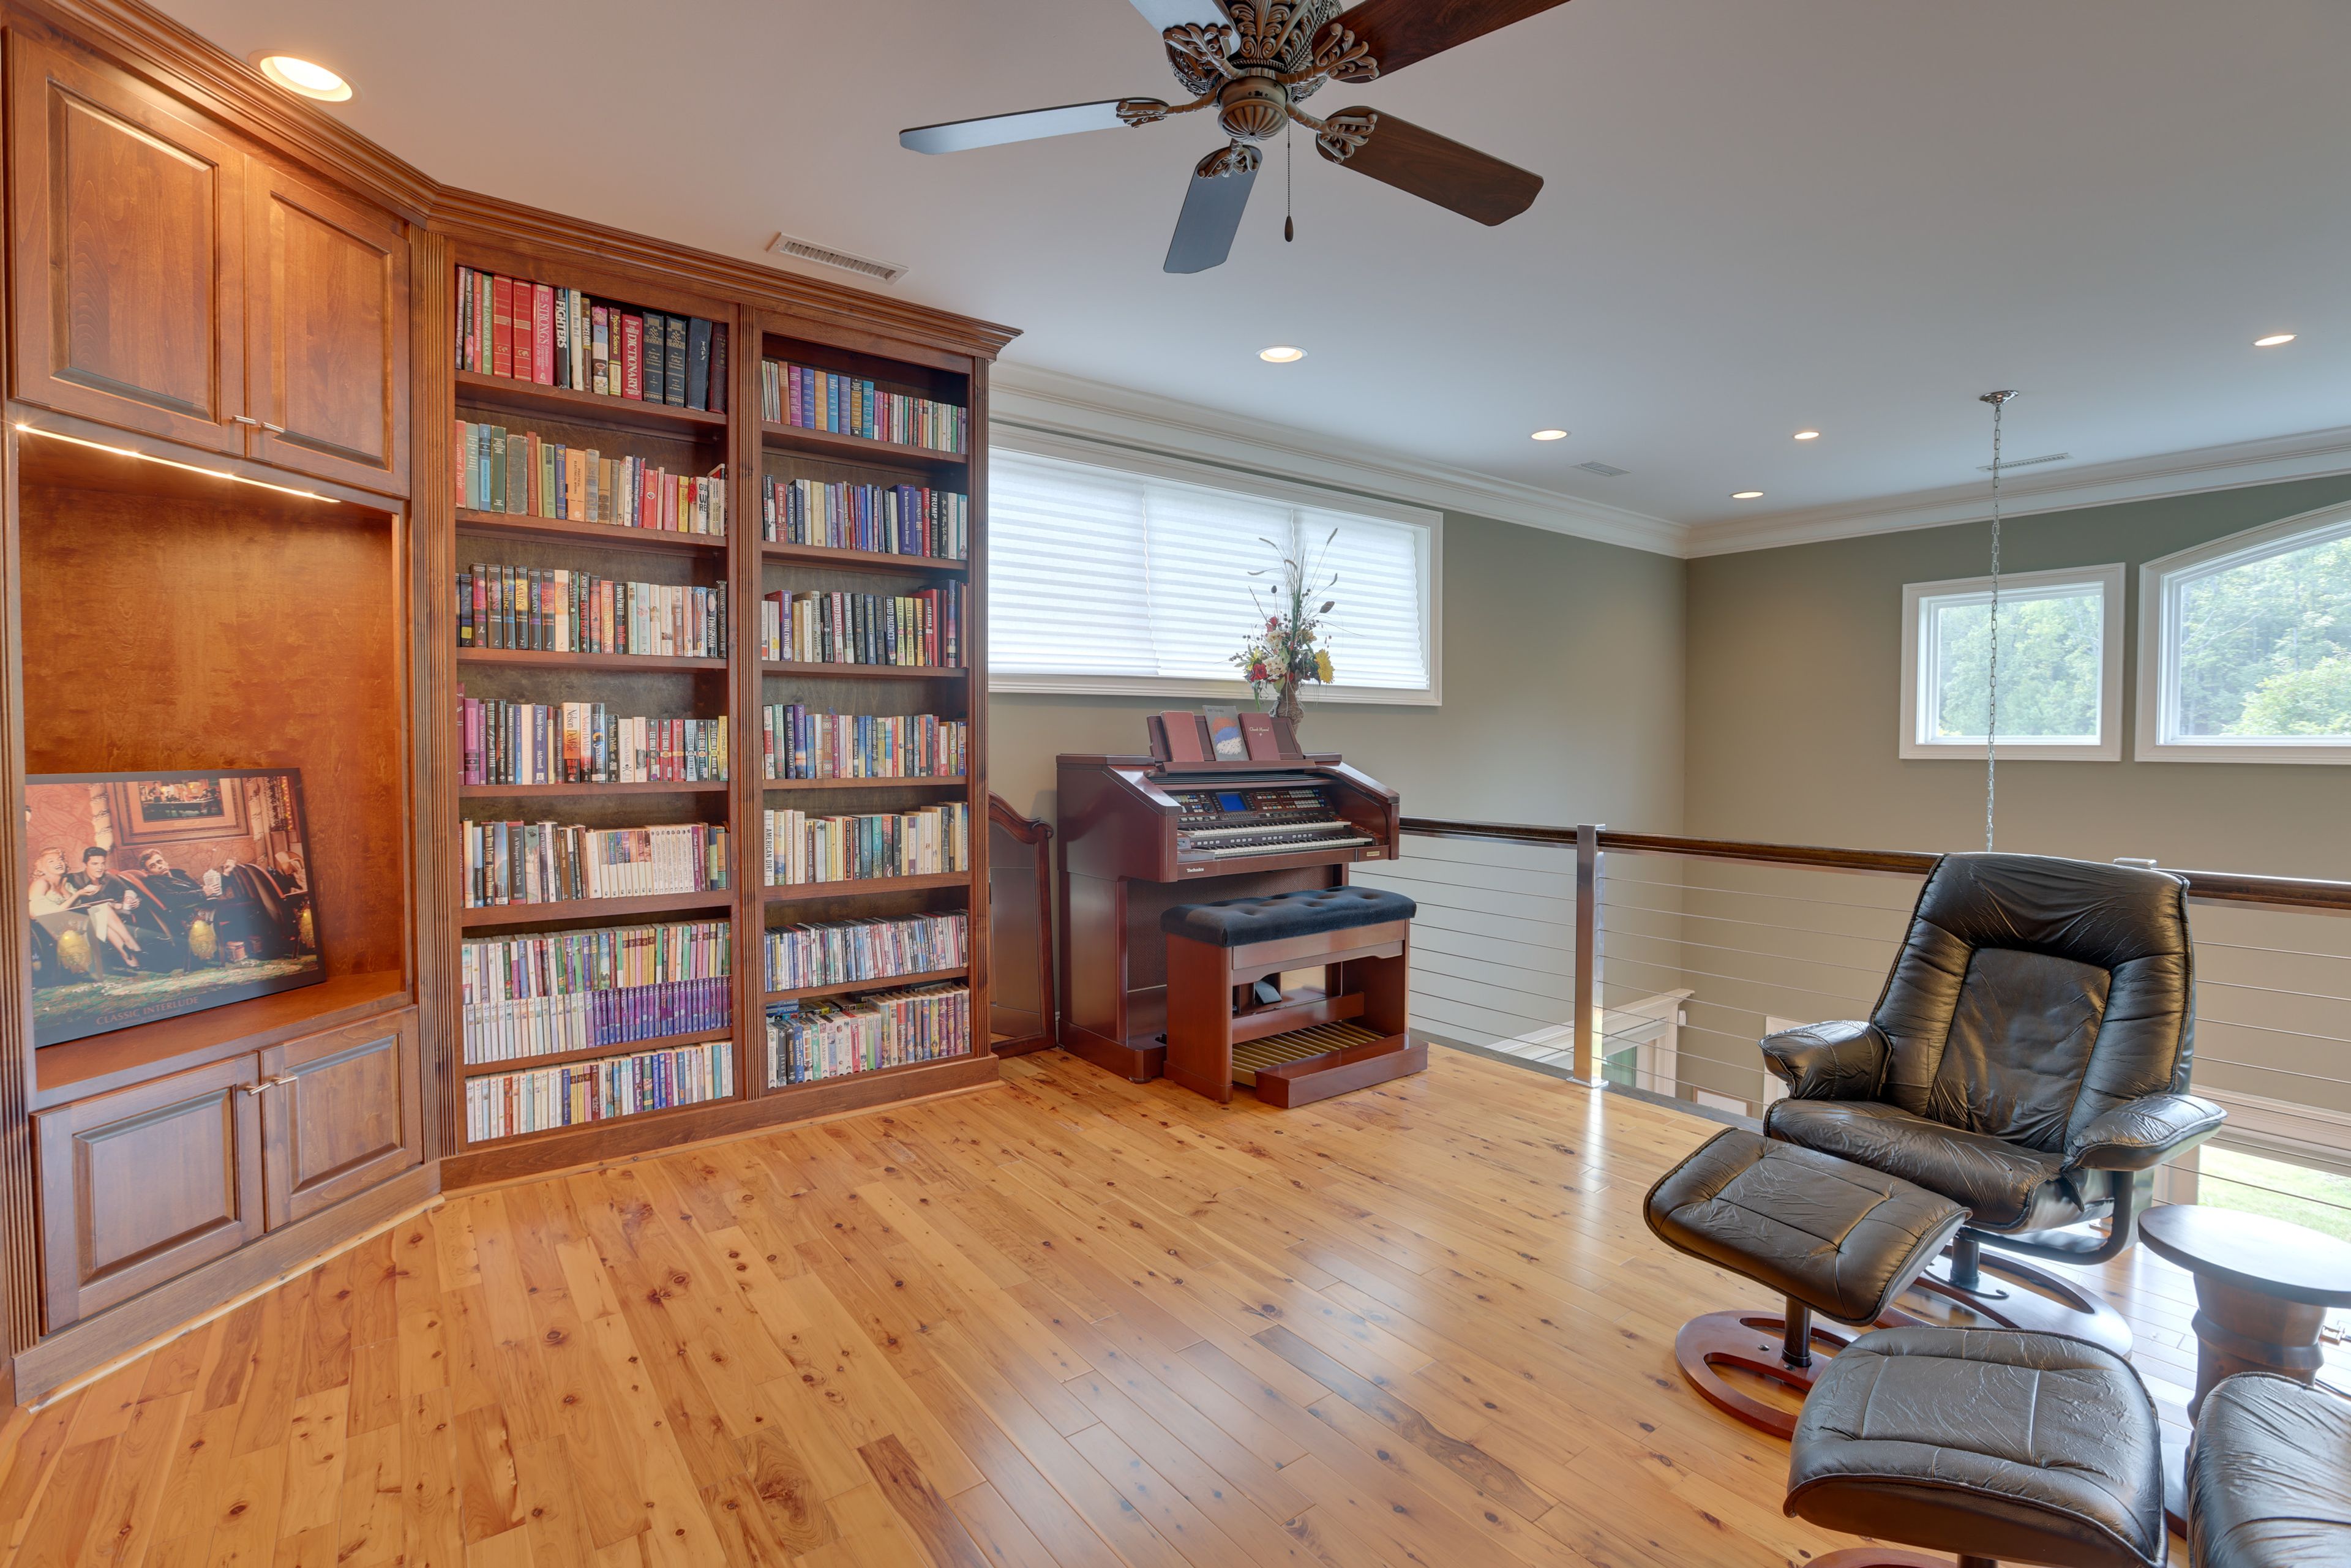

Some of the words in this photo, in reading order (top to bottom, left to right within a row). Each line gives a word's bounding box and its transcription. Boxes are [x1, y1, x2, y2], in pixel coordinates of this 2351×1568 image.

[556, 301, 566, 348] FIGHTERS
[628, 334, 637, 390] DICTIONARY
[567, 709, 577, 728] Nelson
[567, 730, 577, 751] DeMille
[96, 1009, 140, 1025] CLASSIC
[143, 996, 198, 1015] INTERLUDE
